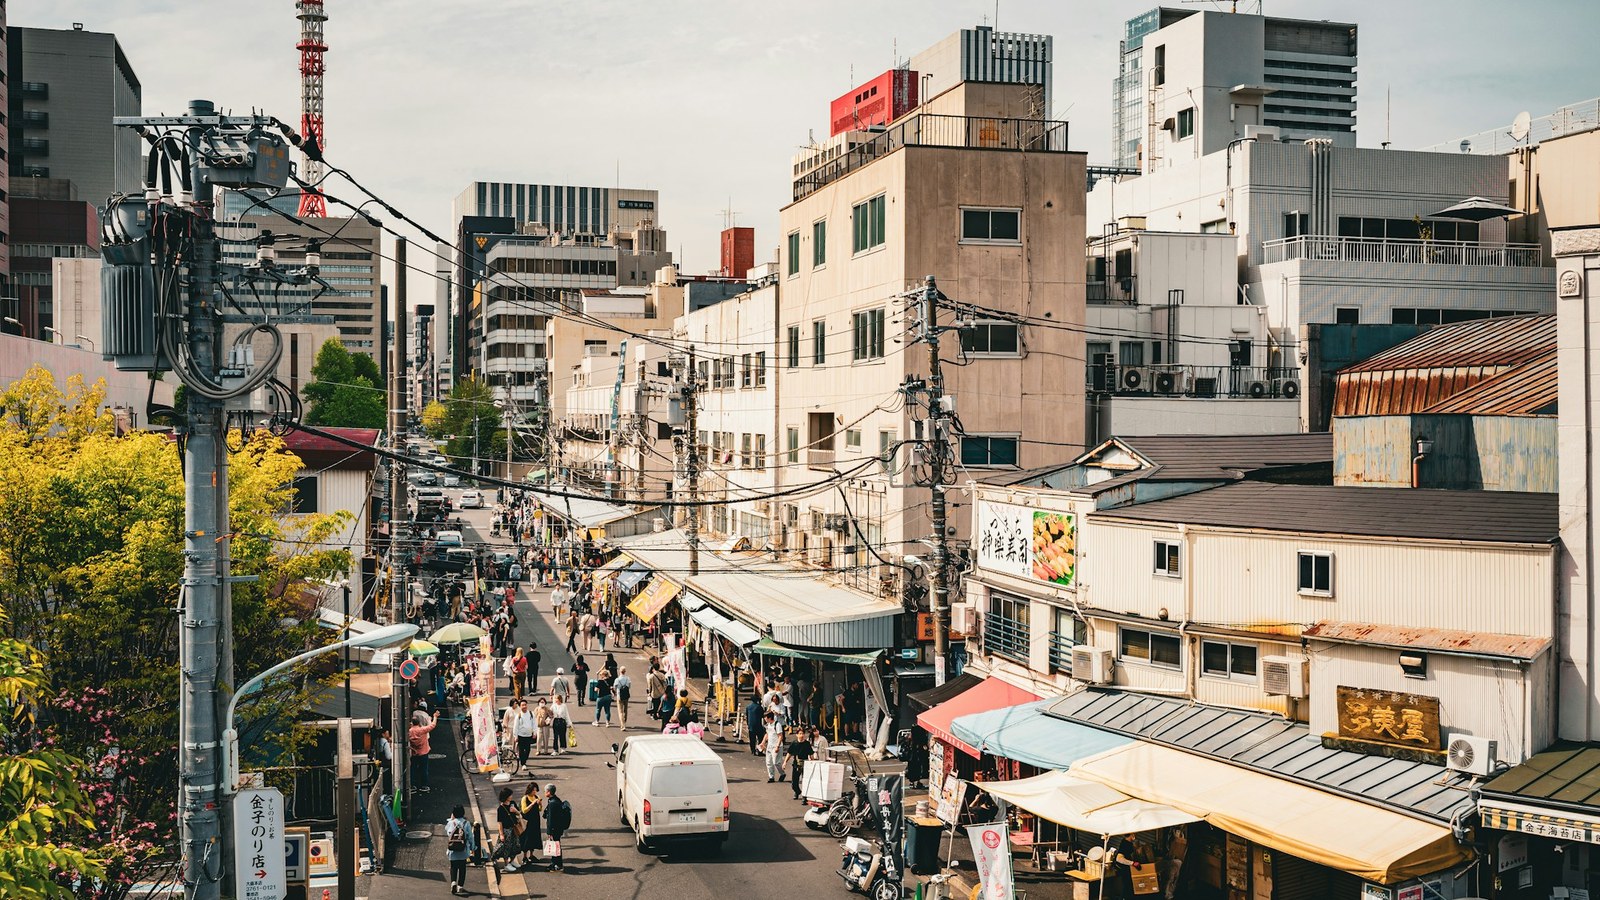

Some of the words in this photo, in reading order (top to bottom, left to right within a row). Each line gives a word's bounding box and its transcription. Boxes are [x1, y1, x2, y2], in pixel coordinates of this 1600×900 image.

[982, 530, 1028, 564] 神楽寿司
[250, 794, 265, 868] 金子のり店
[1525, 823, 1582, 840] 金子海苔店
